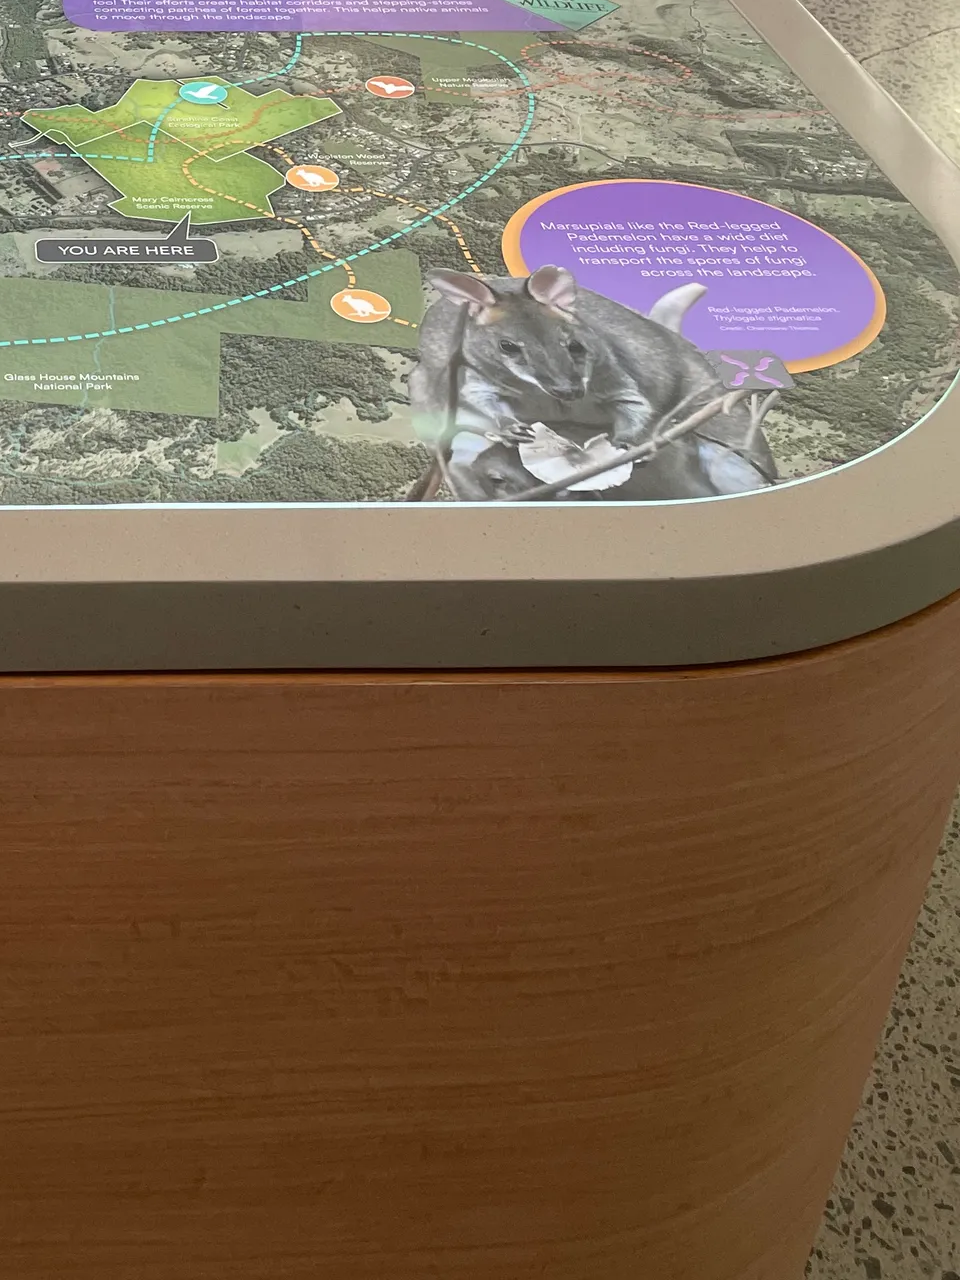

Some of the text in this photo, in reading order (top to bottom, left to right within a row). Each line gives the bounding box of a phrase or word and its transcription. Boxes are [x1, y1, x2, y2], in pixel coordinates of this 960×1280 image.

[149, 14, 199, 22] through
[540, 222, 781, 232] Marsupials like the Red-legged
[58, 246, 194, 255] YOU ARE HERE
[696, 268, 724, 277] the
[727, 268, 816, 278] landscape.
[4, 373, 139, 382] Glass House Mountains
[86, 382, 113, 390] Park
